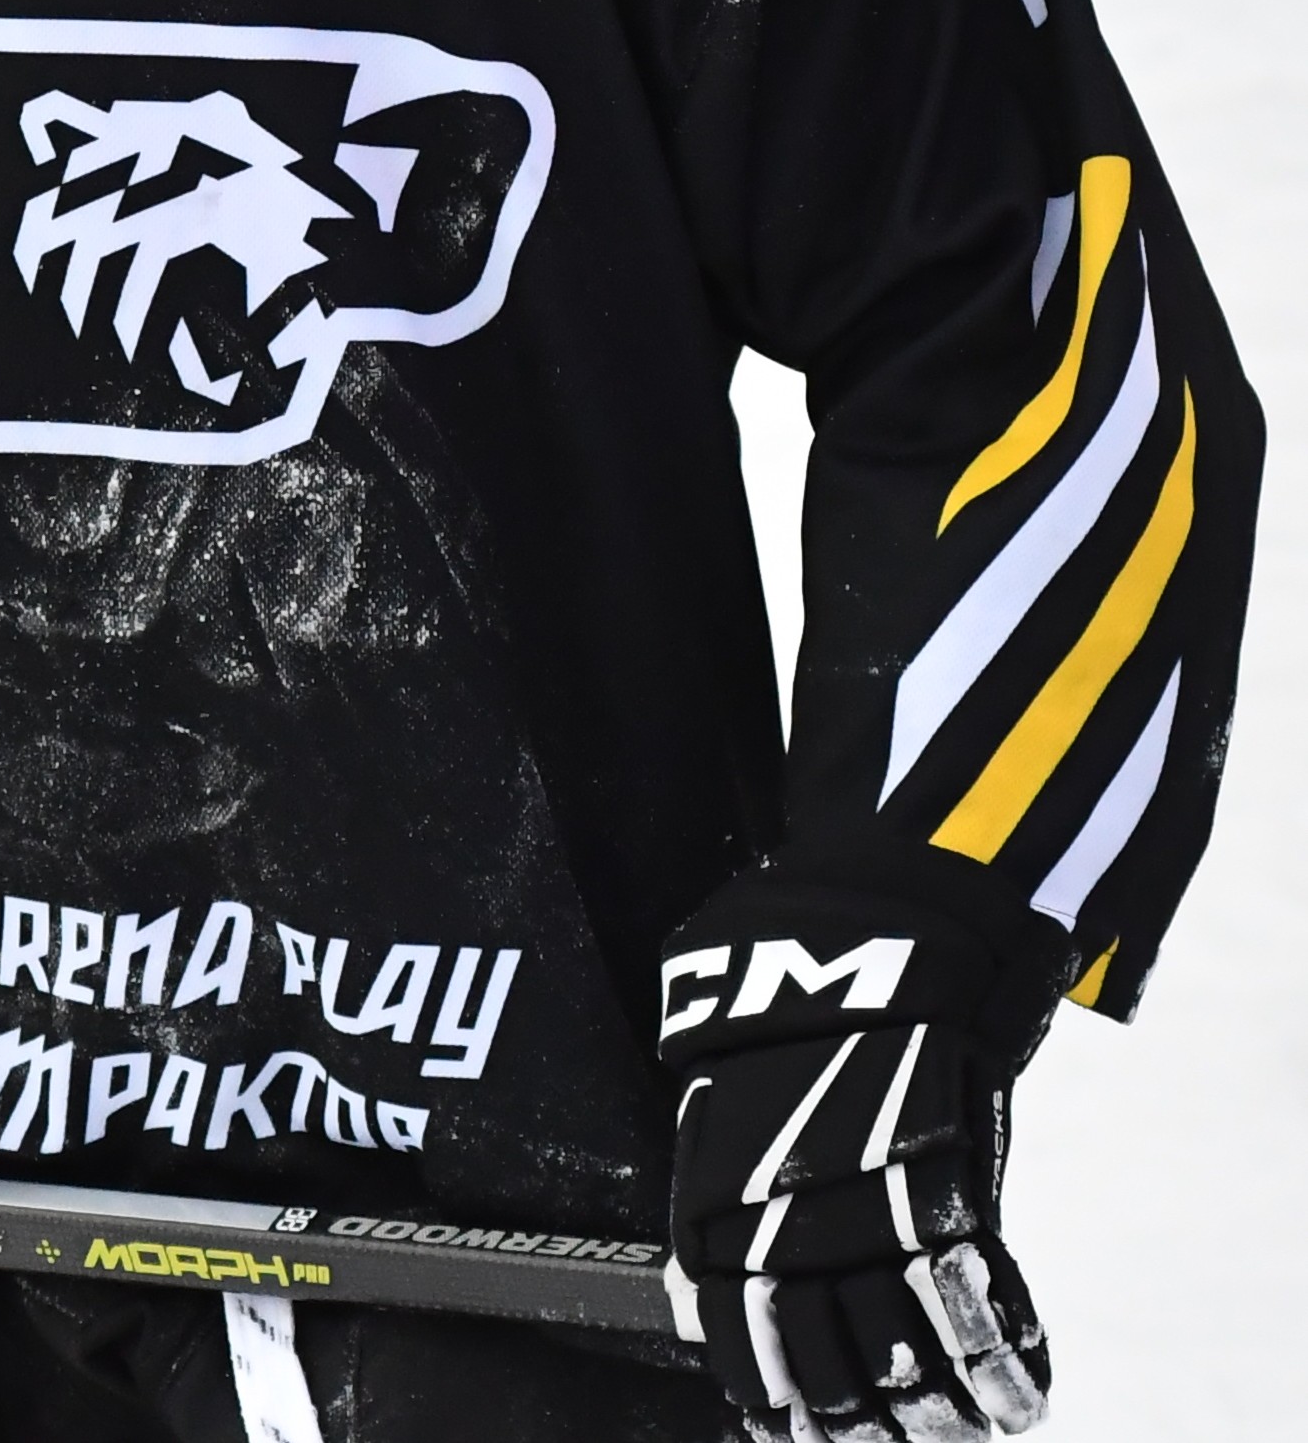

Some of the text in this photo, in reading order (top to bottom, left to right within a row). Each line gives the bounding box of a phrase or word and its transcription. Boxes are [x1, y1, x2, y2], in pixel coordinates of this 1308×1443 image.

[660, 937, 916, 1041] CM
[990, 1088, 1005, 1203] TACKS
[83, 1236, 331, 1287] MORPH PRO
[327, 1215, 663, 1265] SHERWOOD
